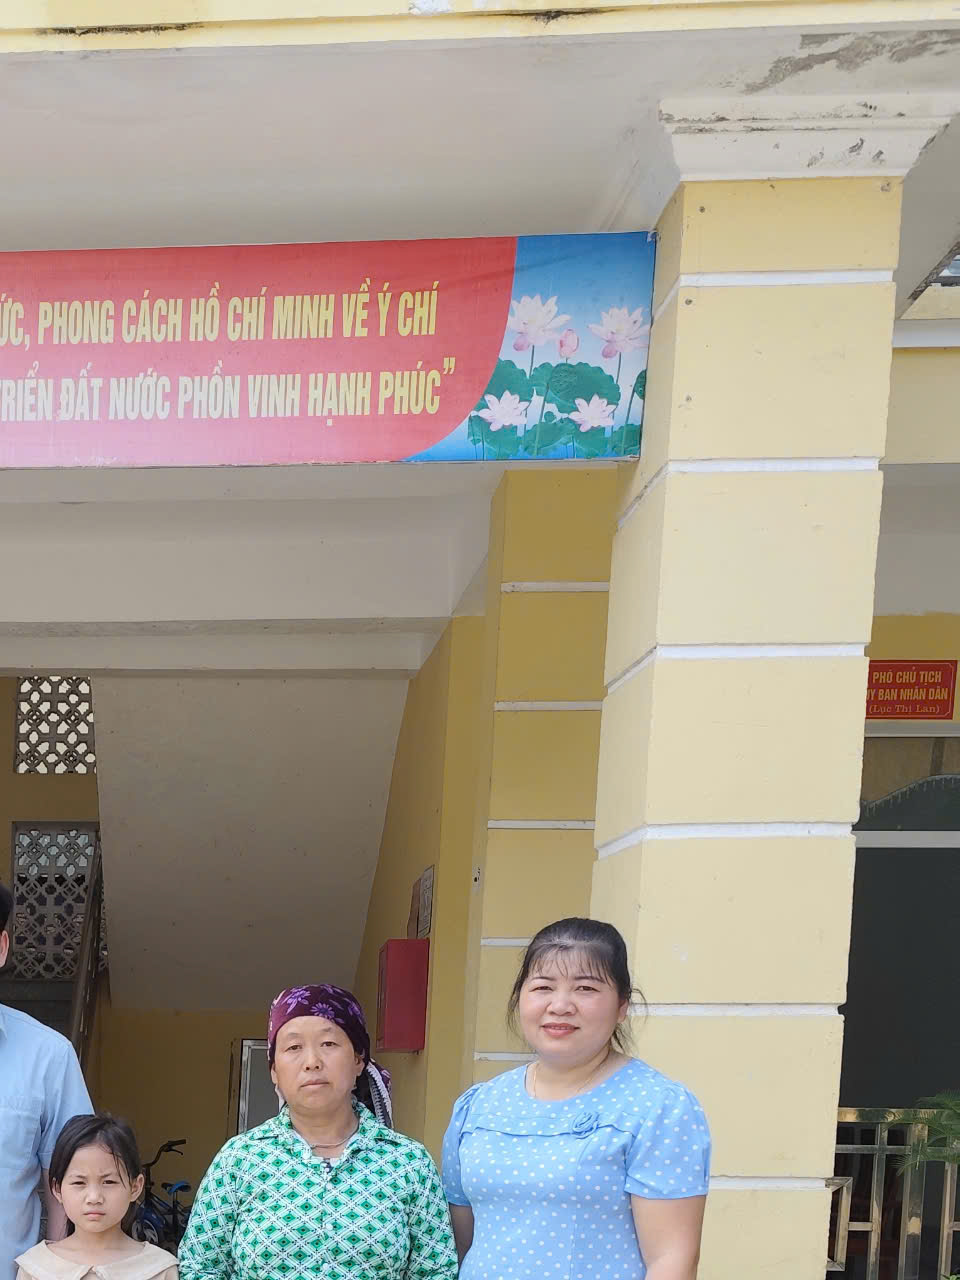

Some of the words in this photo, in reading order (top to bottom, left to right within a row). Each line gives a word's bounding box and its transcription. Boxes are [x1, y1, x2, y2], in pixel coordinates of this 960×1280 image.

[38, 300, 115, 344] PHONG
[122, 290, 182, 342] CÁCH
[190, 282, 220, 341] HỒ
[227, 287, 268, 340] CHÍ
[272, 294, 335, 339] MINH
[342, 278, 370, 338] VỀ
[378, 282, 390, 336] Ý
[397, 281, 439, 335] CHÍ
[59, 362, 102, 421] ĐẤT
[108, 368, 171, 420] NƯỚC
[178, 360, 240, 419] PHỒN
[248, 373, 301, 417] VINH
[307, 372, 371, 426] HẠNH
[378, 357, 456, 415] PHÚC”
[873, 670, 892, 683] PHÓ
[896, 666, 916, 683] CHỦ
[919, 671, 942, 685] TỊCH
[878, 689, 897, 700] BAN
[900, 686, 926, 700] NHÂN
[929, 686, 948, 700] DÂN
